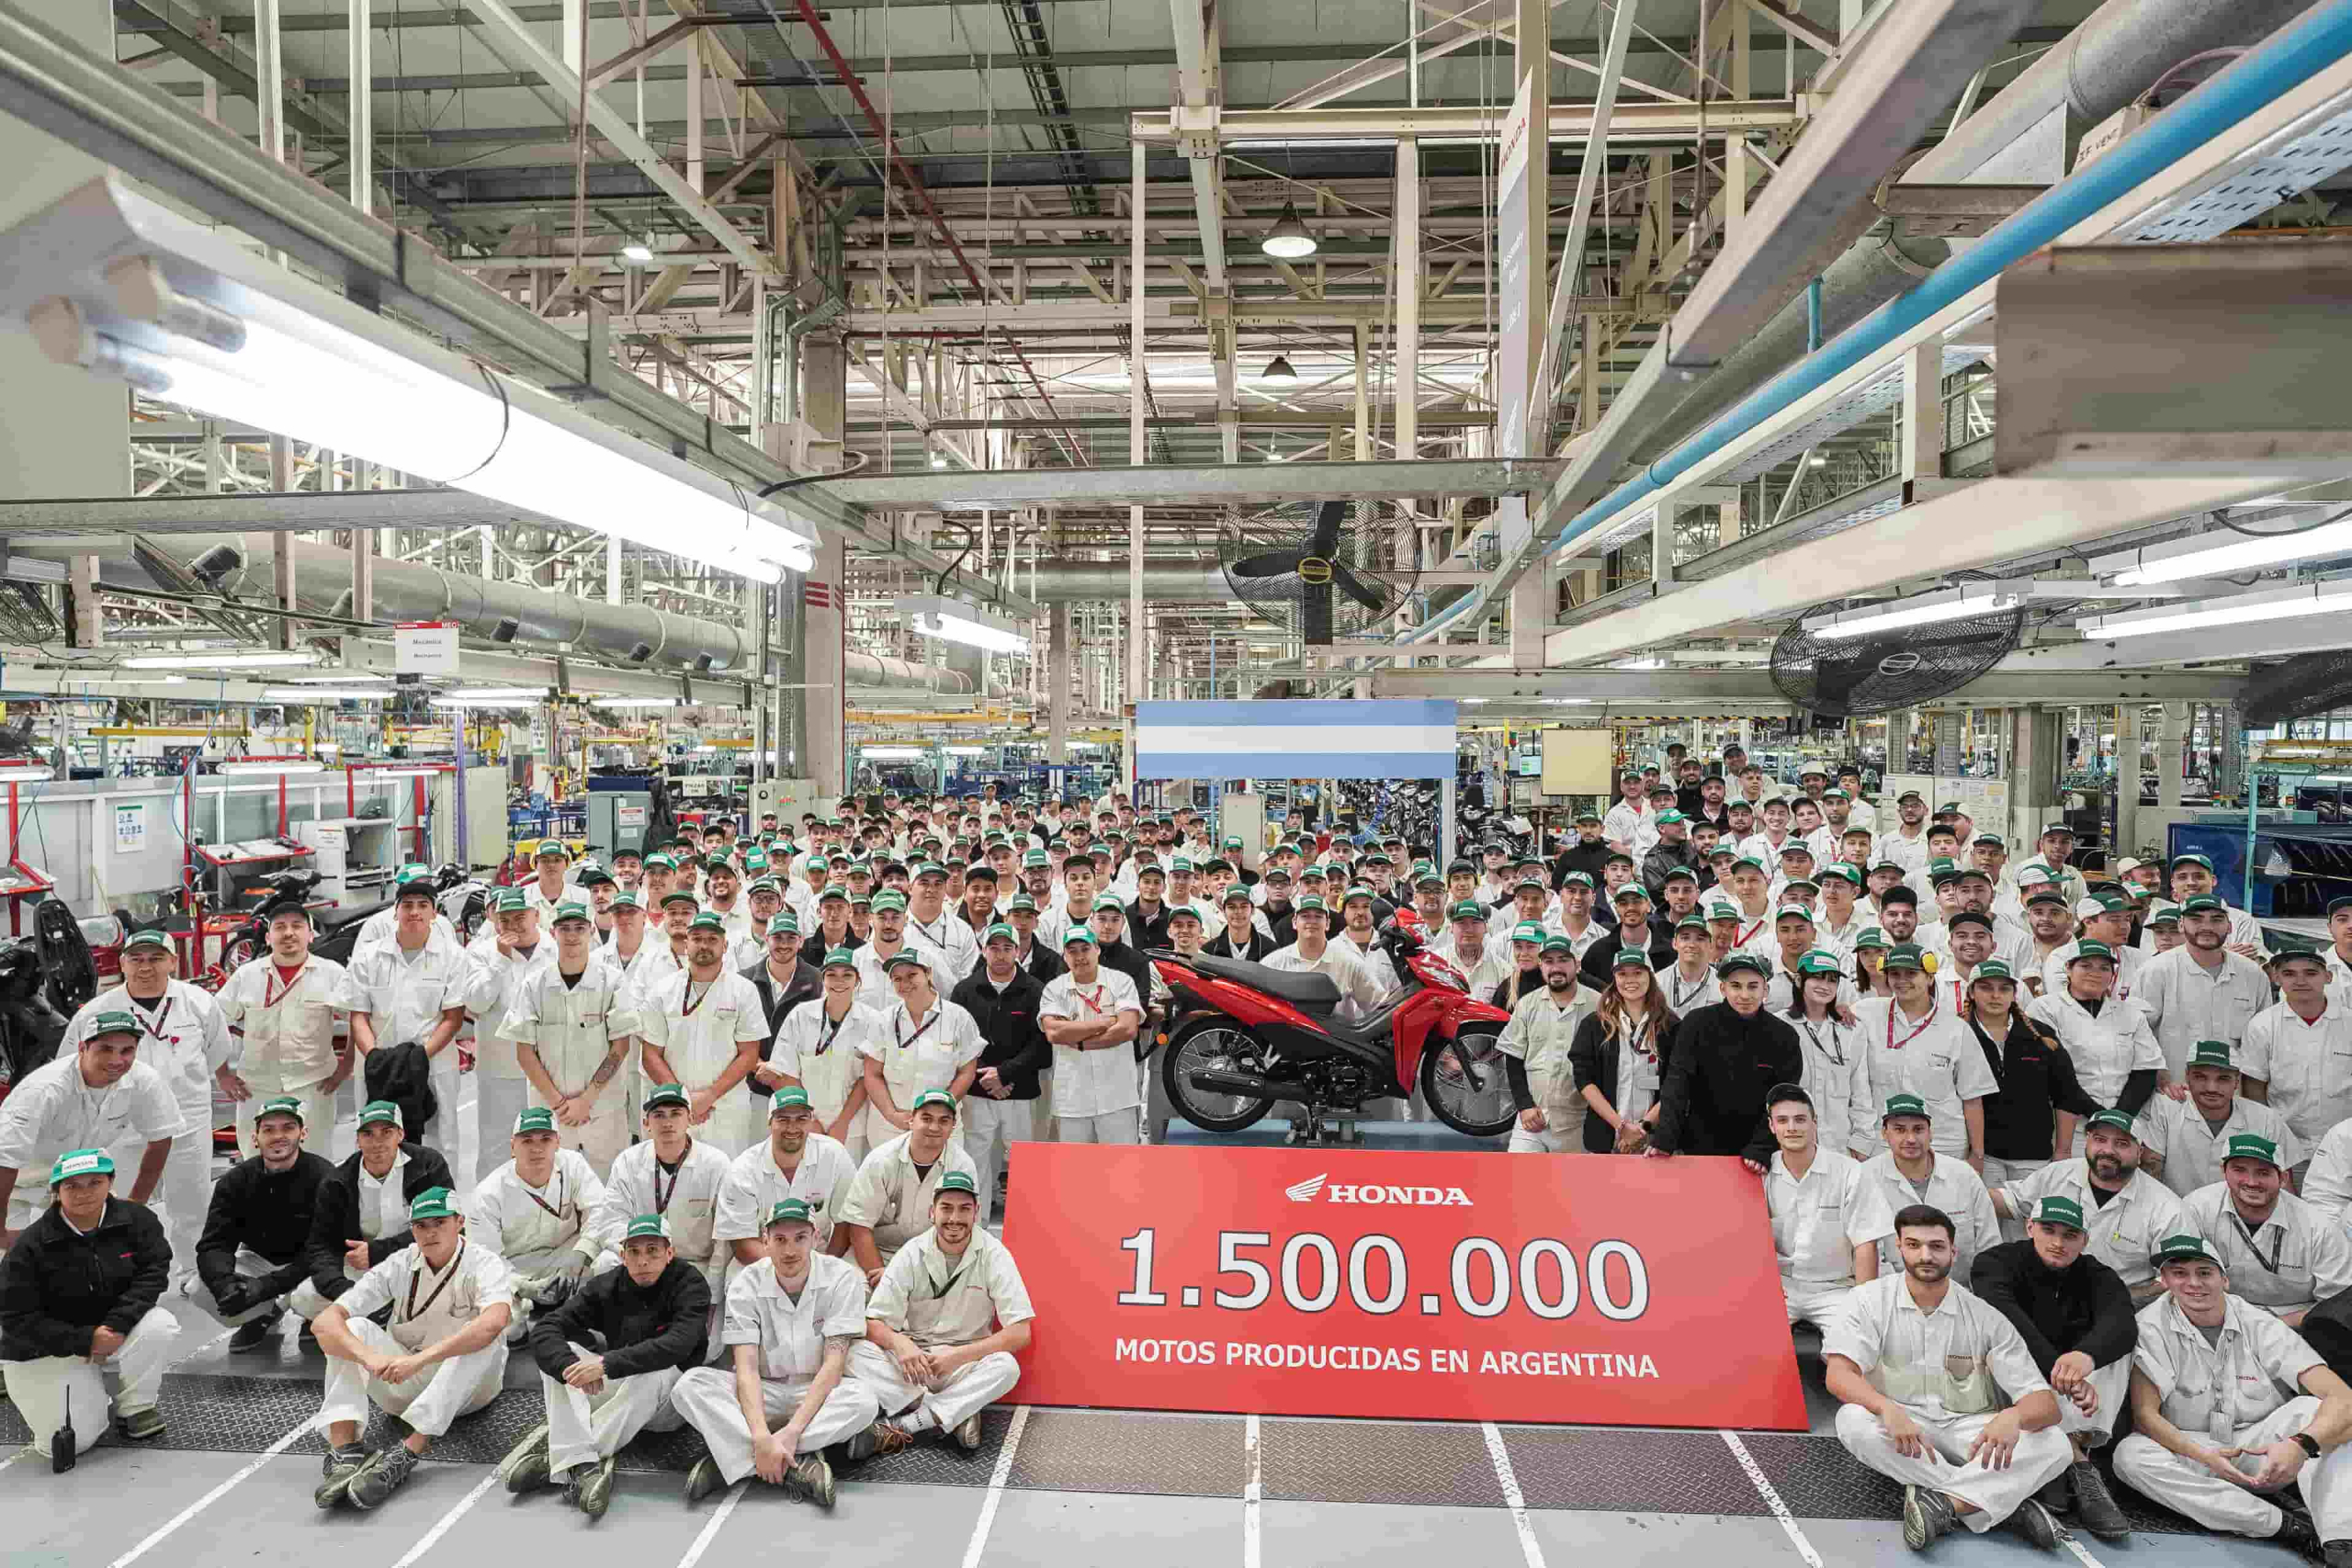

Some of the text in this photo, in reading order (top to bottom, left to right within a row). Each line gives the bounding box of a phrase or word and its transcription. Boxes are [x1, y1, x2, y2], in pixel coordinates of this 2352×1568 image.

[1501, 117, 1526, 172] HONDA
[2199, 1051, 2226, 1059] HONDA
[2236, 1145, 2267, 1155] HONDA
[1328, 1184, 1473, 1205] HONDA
[2048, 1207, 2079, 1219] HONDA
[1117, 1228, 1649, 1321] 1.500.000
[1115, 1338, 1659, 1378] MOTOS PRODUCIDAS EN ARGENTINA
